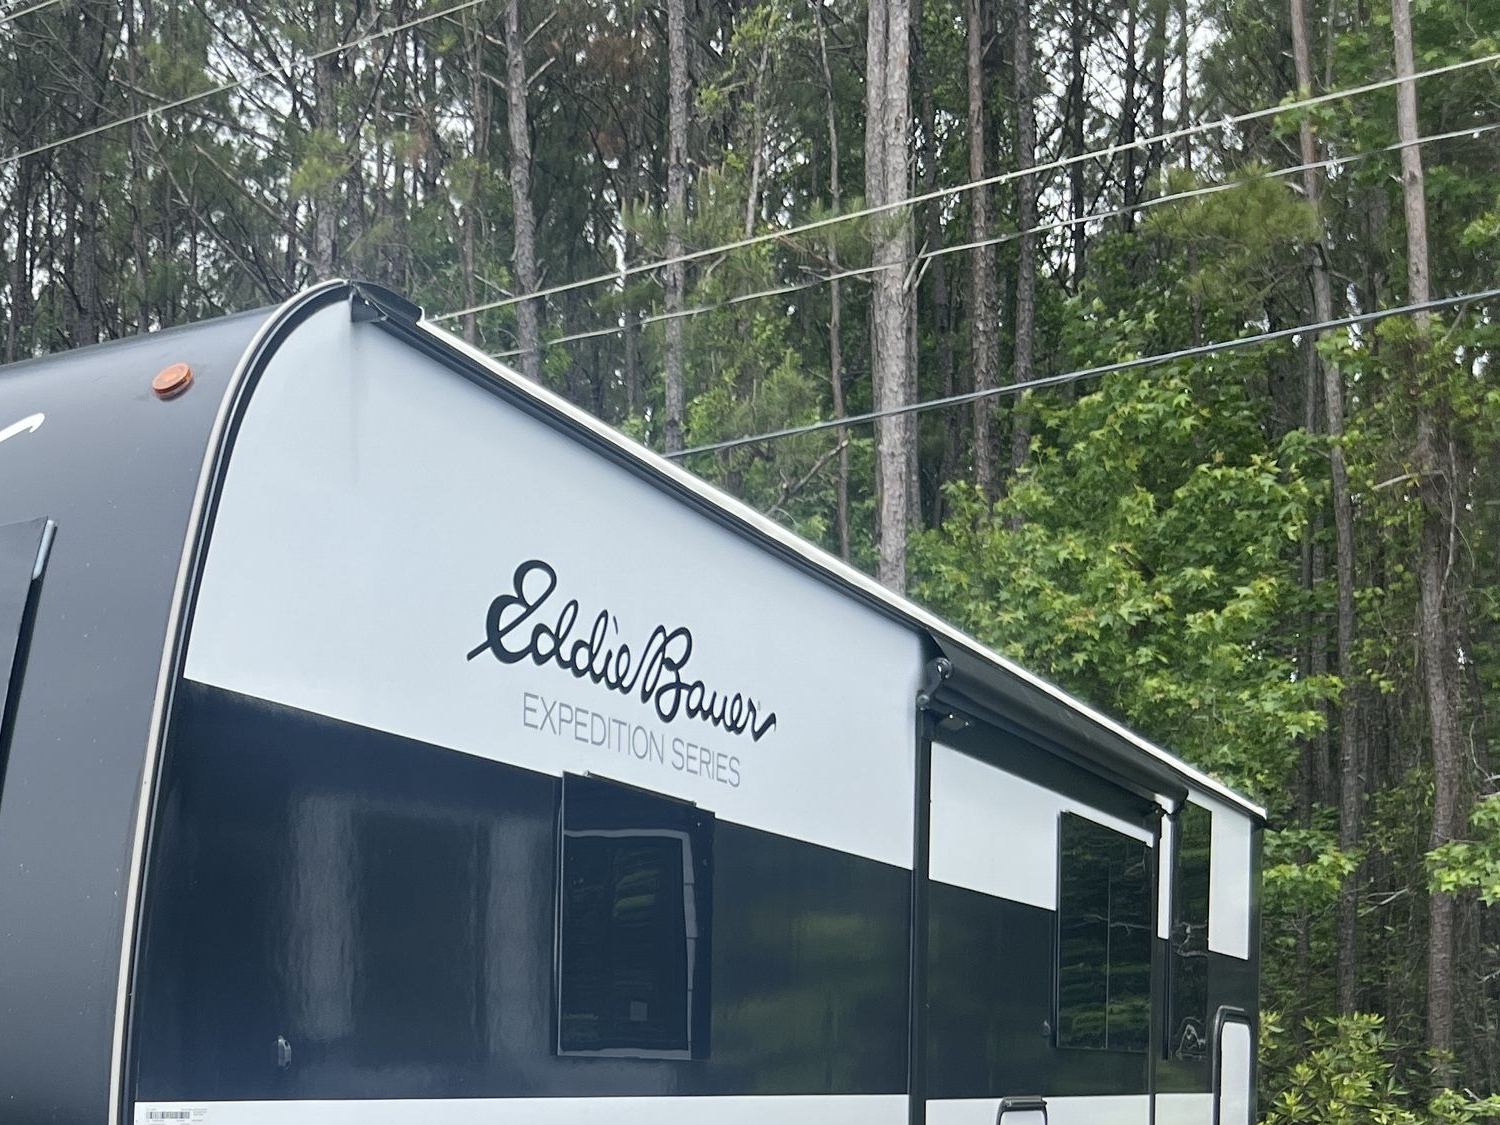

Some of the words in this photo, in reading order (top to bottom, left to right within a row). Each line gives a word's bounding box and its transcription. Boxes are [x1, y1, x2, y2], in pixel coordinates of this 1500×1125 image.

[466, 559, 633, 695] Eddie
[639, 624, 777, 743] Bauer
[522, 691, 665, 765] EXPEDITION
[671, 737, 742, 788] SERIES
